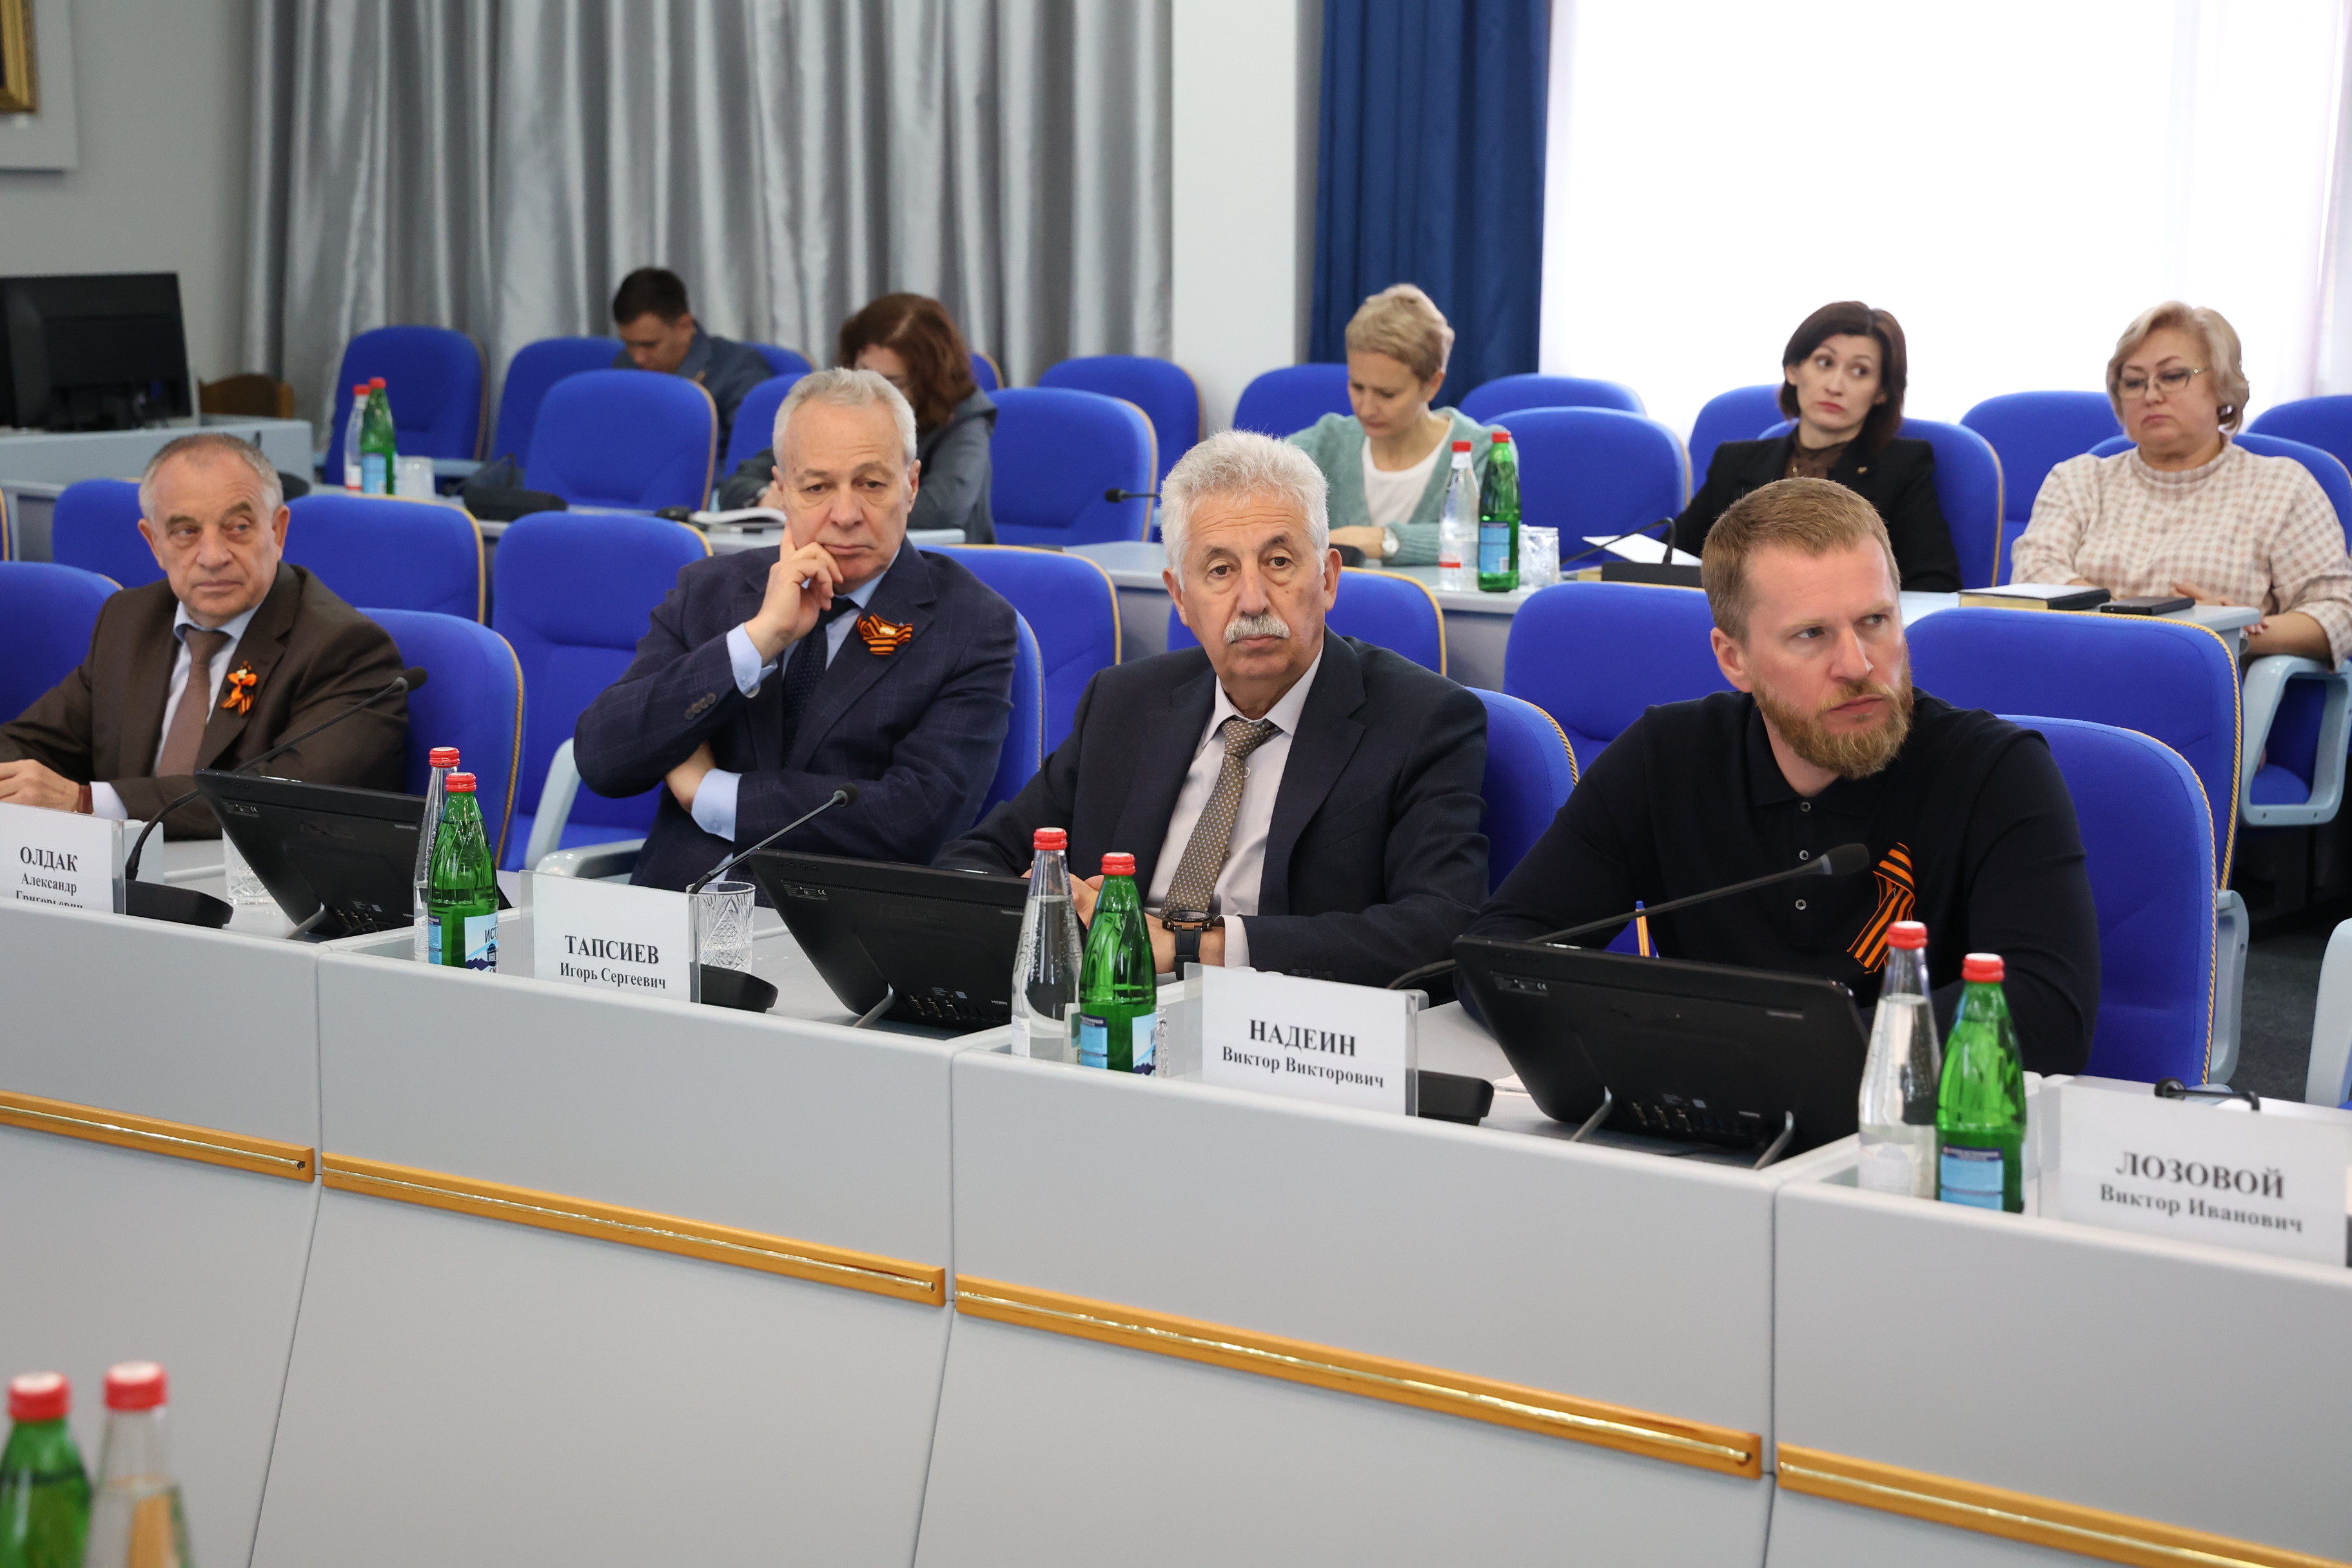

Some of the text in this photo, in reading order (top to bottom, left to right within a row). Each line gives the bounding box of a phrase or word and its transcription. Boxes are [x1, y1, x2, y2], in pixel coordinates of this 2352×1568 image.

[20, 846, 78, 872] ОЛДАК
[21, 872, 77, 896] Александр
[485, 926, 498, 943] ИСТ
[565, 935, 659, 964] ТАПСИЕВ
[560, 962, 666, 989] Игорь Сергеевич
[1250, 1019, 1356, 1057] НАДЕИН
[1222, 1046, 1384, 1088] Виктор Викторович
[2115, 1152, 2285, 1199] ЛОЗОВОЙ
[2100, 1183, 2302, 1233] Виктор Иванович
